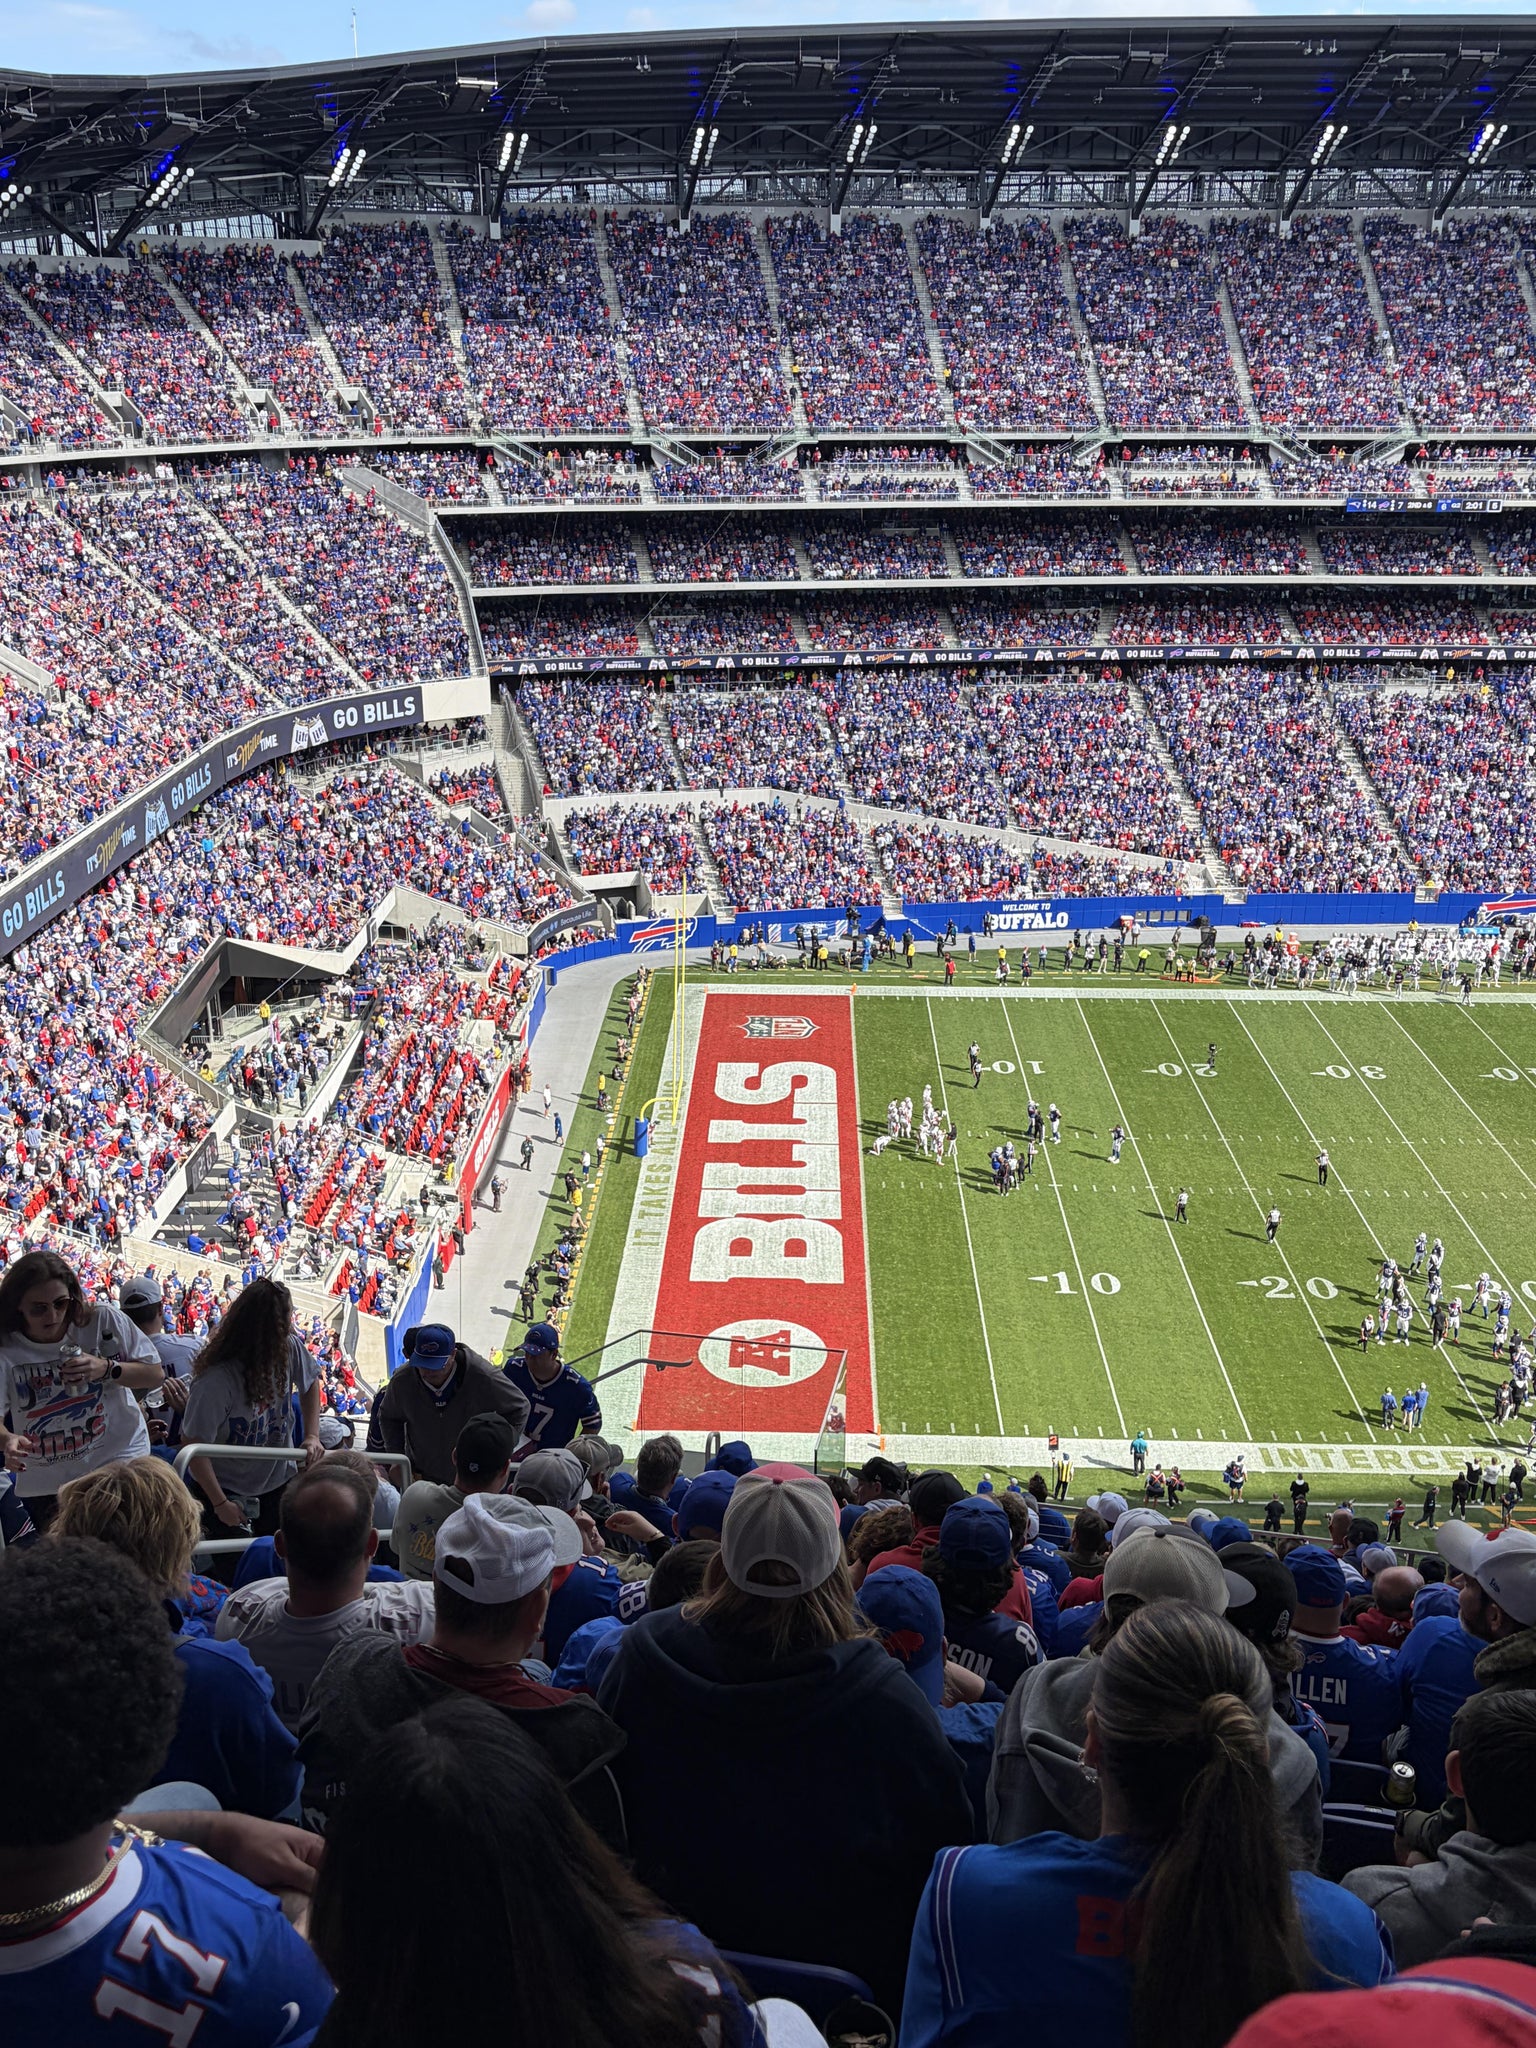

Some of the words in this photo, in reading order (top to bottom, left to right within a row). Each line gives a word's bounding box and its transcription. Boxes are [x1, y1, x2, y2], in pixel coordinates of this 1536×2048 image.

[1465, 500, 1483, 509] 2:01
[742, 658, 754, 666] GO
[755, 657, 780, 665] BILLS
[935, 653, 947, 661] GO
[948, 653, 972, 661] BILLS
[1126, 650, 1138, 658] GO
[1322, 649, 1334, 657] GO
[1336, 648, 1361, 657] BILLS
[1514, 650, 1526, 658] GO
[545, 663, 557, 671] GO
[558, 662, 584, 671] BILLS
[333, 709, 358, 730] GO
[363, 696, 416, 724] BILLS
[227, 752, 238, 769] IT'S
[236, 729, 264, 771] Miller
[259, 734, 279, 752] TIME
[171, 783, 185, 810] GO
[185, 762, 211, 800] BILLS
[86, 853, 99, 875] IT'S
[96, 820, 125, 875] Miller
[121, 825, 137, 848] TIME
[2, 902, 23, 938] GO
[25, 870, 65, 922] BILLS
[1002, 903, 1039, 912] WELCOME
[1041, 903, 1051, 911] TO
[990, 911, 1069, 931] BUFFALO
[992, 1060, 1046, 1075] 10
[1325, 1065, 1388, 1080] 30
[651, 1128, 678, 1156] ALL
[689, 1060, 845, 1284] BILLS
[638, 1163, 672, 1220] TAKES
[632, 1229, 661, 1247] IT
[1051, 1271, 1121, 1295] 10
[1260, 1276, 1339, 1300] 20
[566, 1367, 582, 1385] 17
[528, 1402, 555, 1442] 7
[1050, 1435, 1058, 1446] 2
[94, 1909, 228, 2048] 17
